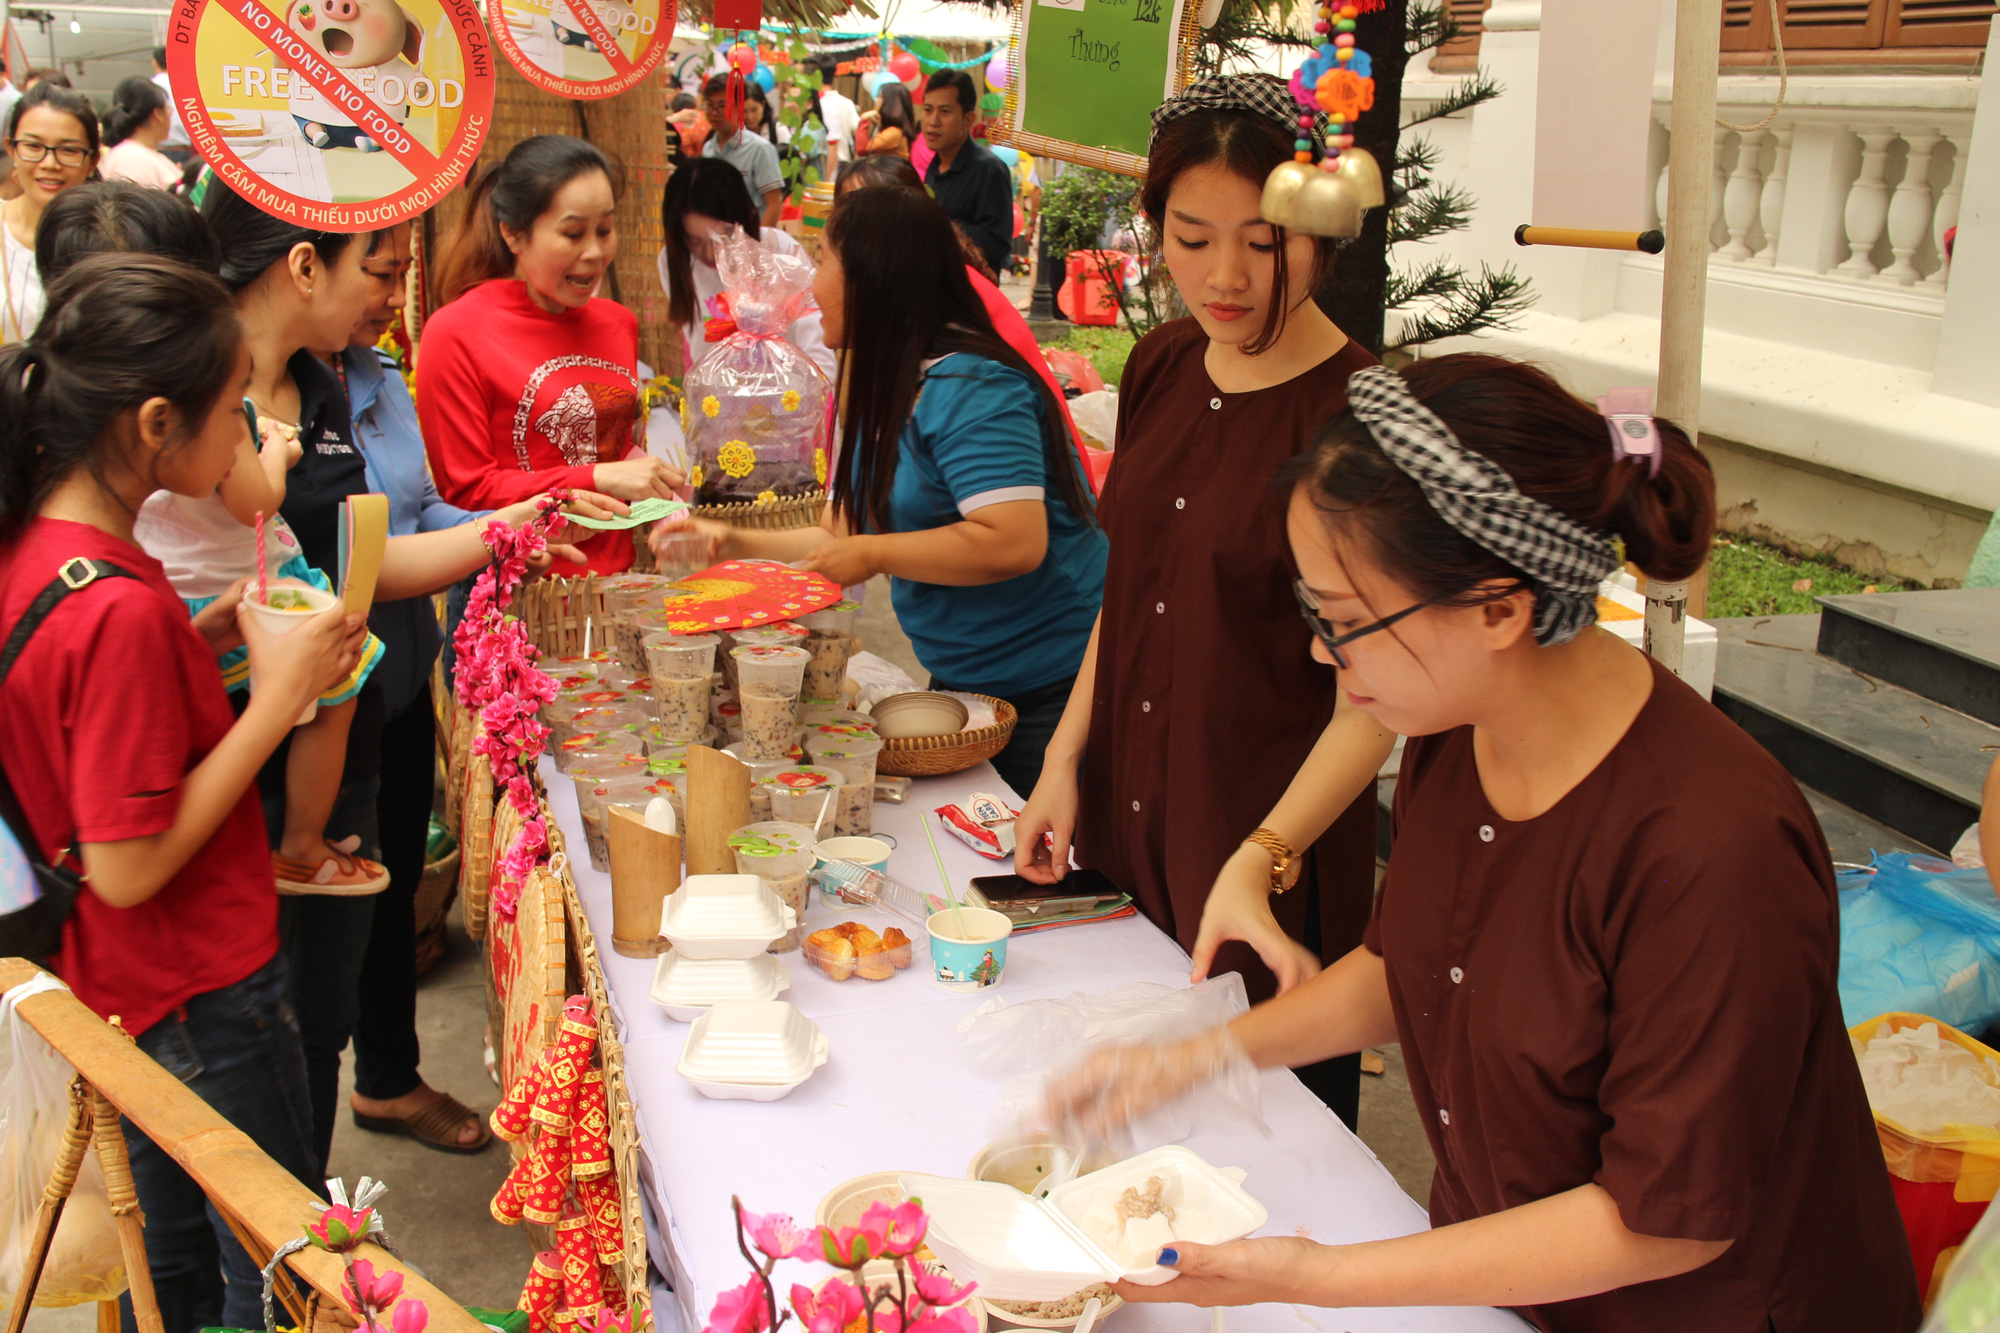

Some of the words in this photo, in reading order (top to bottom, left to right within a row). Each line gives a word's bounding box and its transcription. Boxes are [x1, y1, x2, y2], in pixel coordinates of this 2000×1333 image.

[175, 20, 191, 44] DT
[467, 32, 488, 77] CẢNH
[578, 7, 596, 27] NO
[591, 26, 618, 59] FOOD
[222, 64, 314, 101] FREE
[356, 73, 464, 109] FOOD
[240, 1, 271, 30] NO
[270, 27, 338, 87] MONEY
[333, 84, 364, 112] NO
[362, 109, 411, 154] FOOD
[519, 60, 541, 83] MUA
[543, 76, 572, 94] THIẾU
[574, 83, 602, 96] DƯỚI
[603, 80, 624, 94] MỌI
[625, 66, 648, 86] HÌNH
[643, 41, 665, 68] THỨC
[182, 97, 225, 164] NGHIÊM
[221, 162, 257, 195] CẤM
[256, 188, 296, 217] MUA
[301, 206, 350, 225] THIẾU
[354, 202, 399, 225] DƯỚI
[399, 187, 433, 214] MỌI
[430, 158, 465, 194] HÌNH
[456, 114, 484, 158] THỨC
